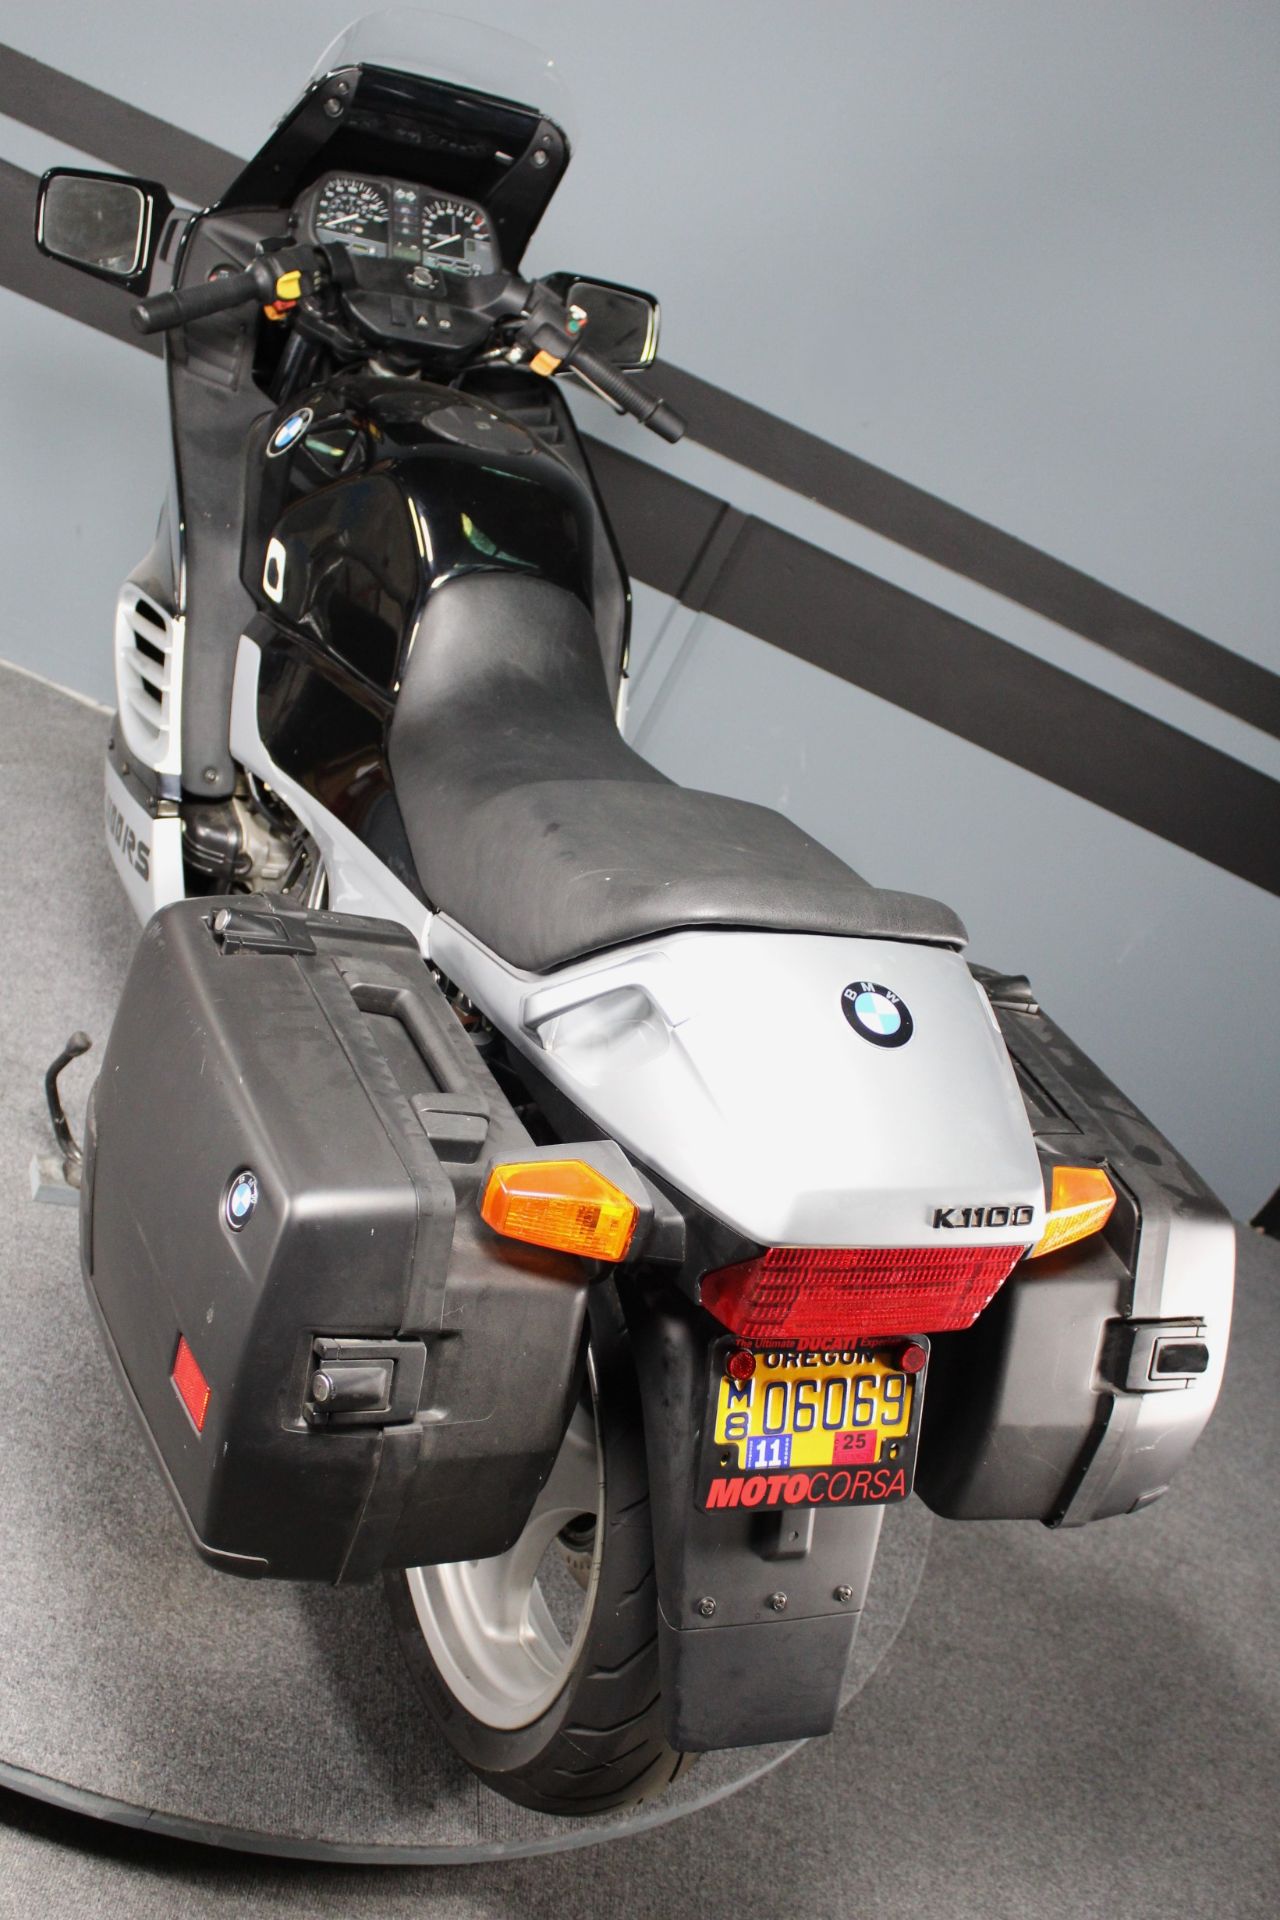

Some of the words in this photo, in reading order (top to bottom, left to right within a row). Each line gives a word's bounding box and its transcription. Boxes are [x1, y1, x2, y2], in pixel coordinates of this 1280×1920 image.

[844, 981, 900, 1004] BMW
[932, 1205, 1035, 1229] K1100
[735, 1338, 753, 1349] The
[755, 1337, 796, 1348] Ultimate
[796, 1336, 858, 1351] DUCATI
[763, 1373, 906, 1435] 06069
[754, 1437, 782, 1468] 11
[842, 1433, 867, 1450] 25
[705, 1469, 906, 1509] MOTOCORSA
